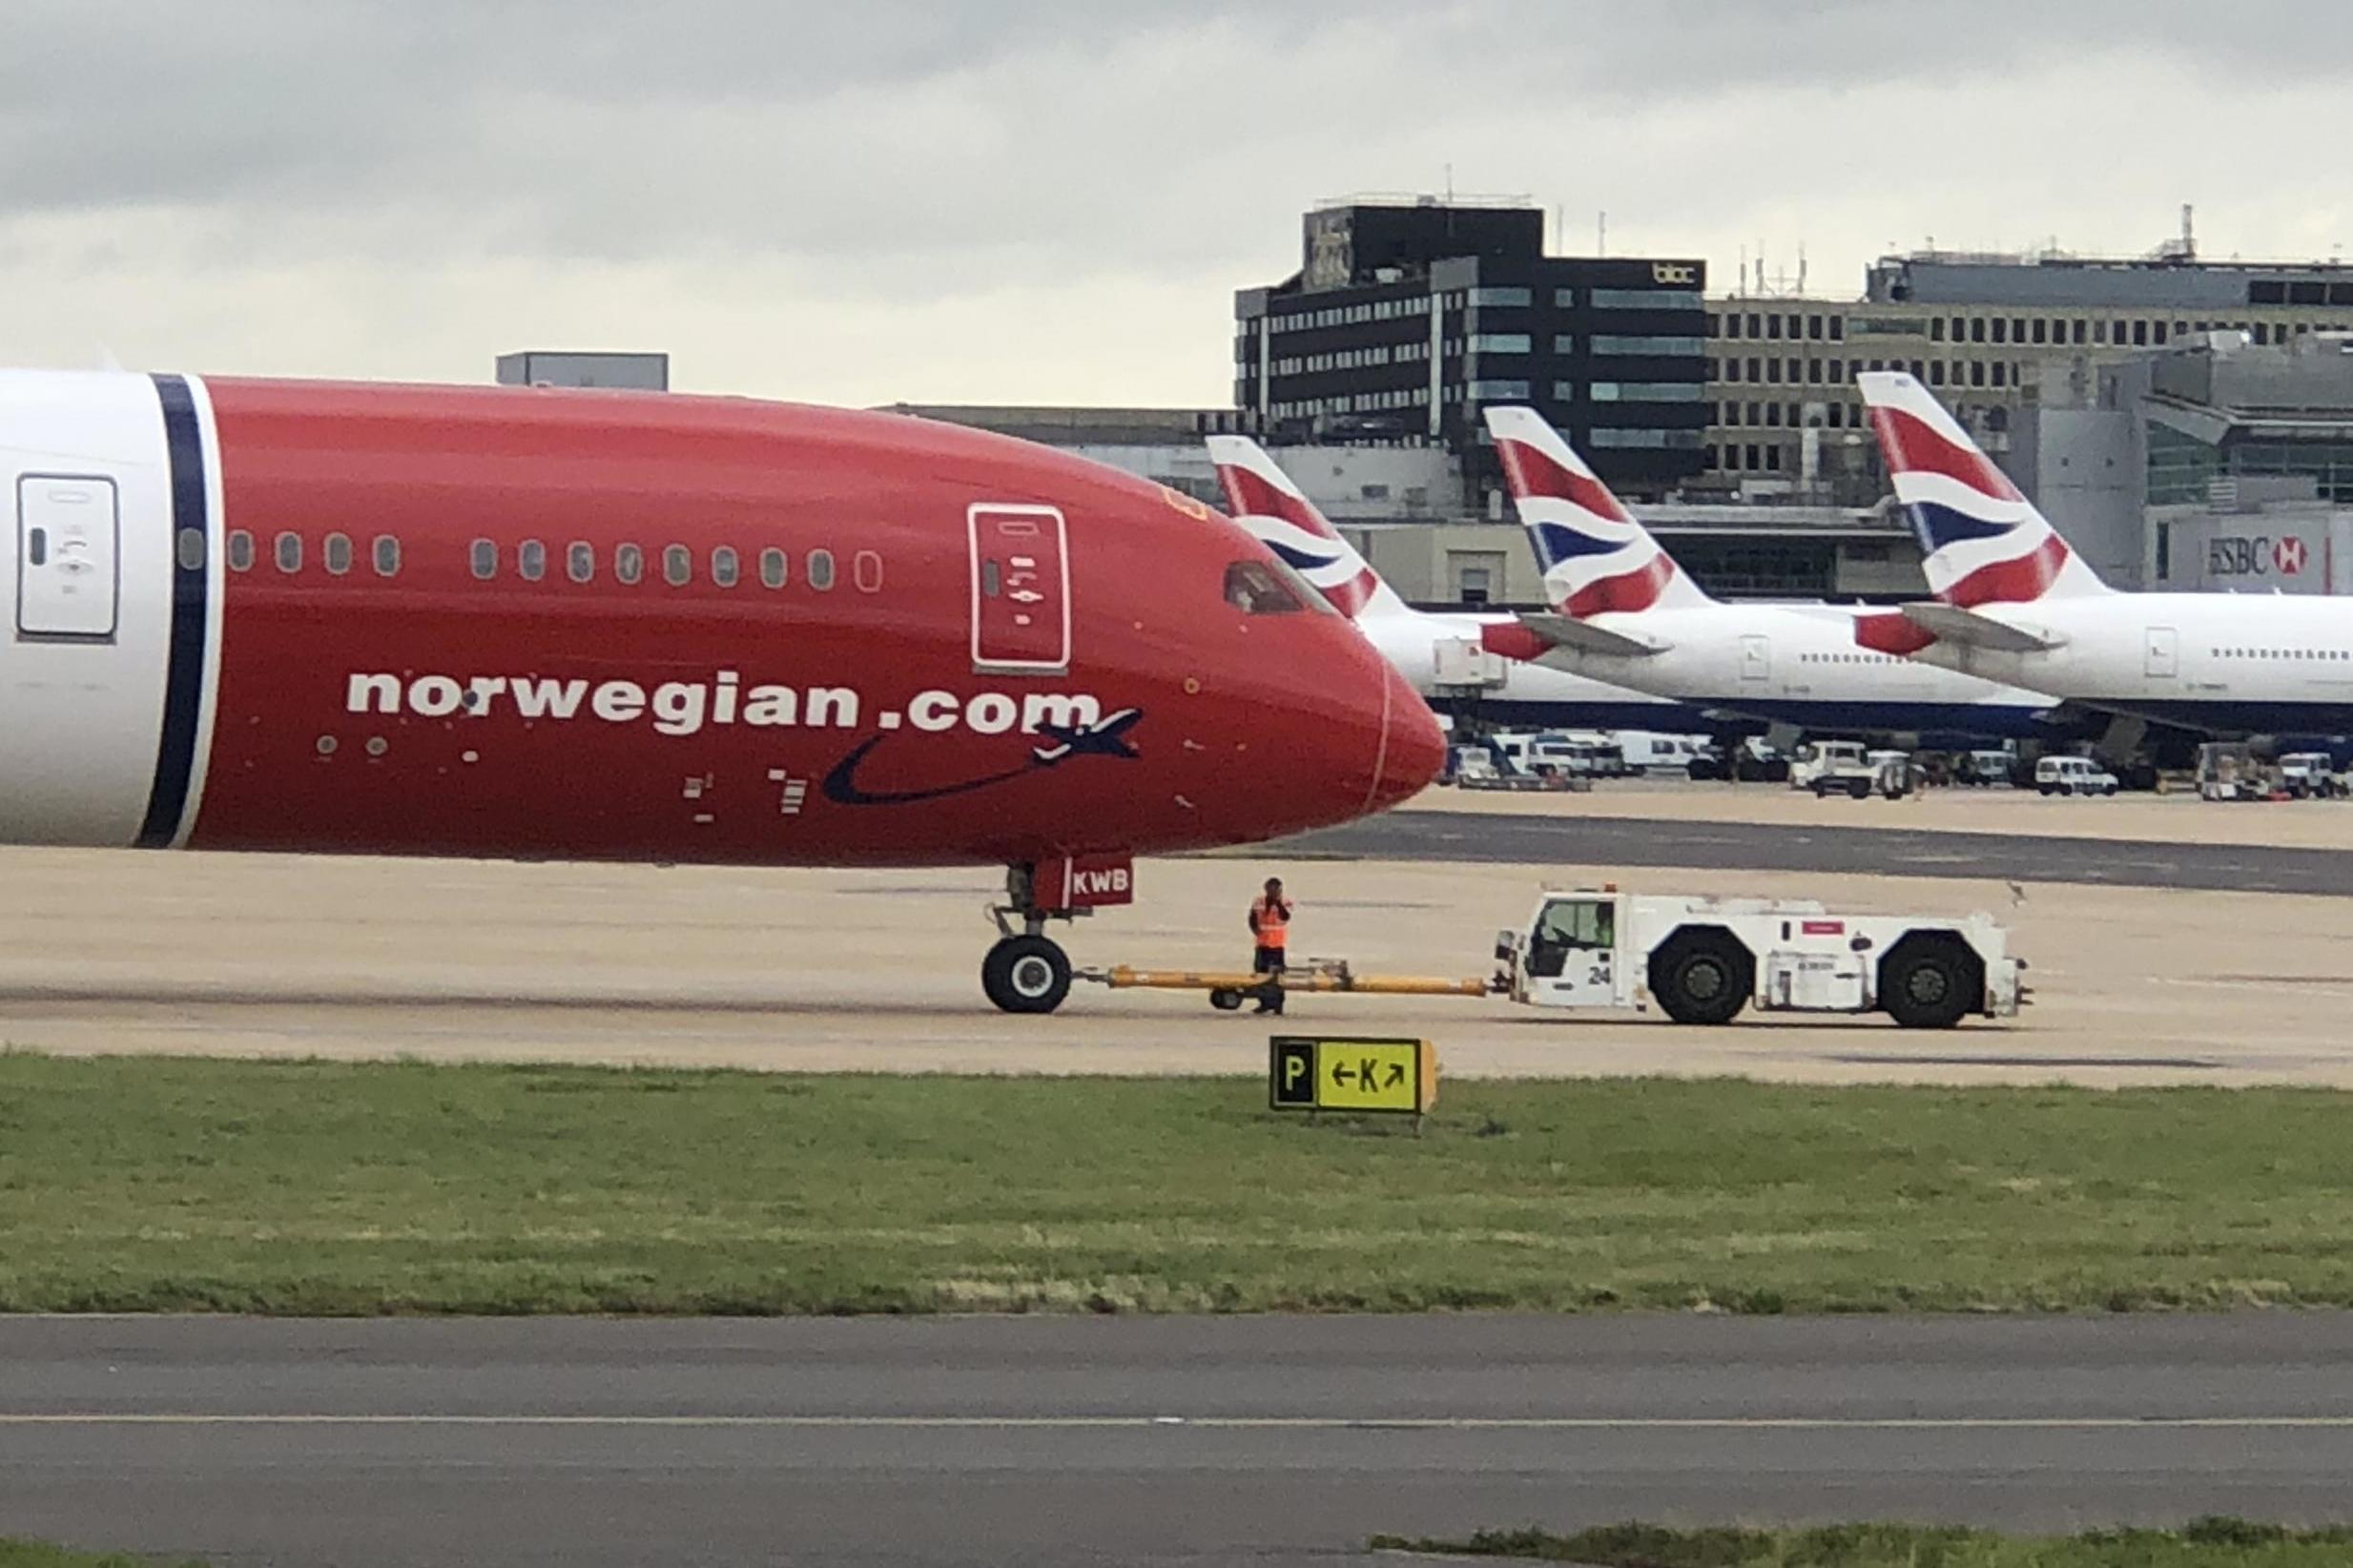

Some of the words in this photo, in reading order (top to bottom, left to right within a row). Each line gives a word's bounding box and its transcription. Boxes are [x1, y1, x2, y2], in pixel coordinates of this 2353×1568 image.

[1073, 868, 1127, 895] KWB
[1588, 966, 1610, 984] 24
[1286, 1055, 1306, 1091] P
[1359, 1059, 1378, 1093] K
